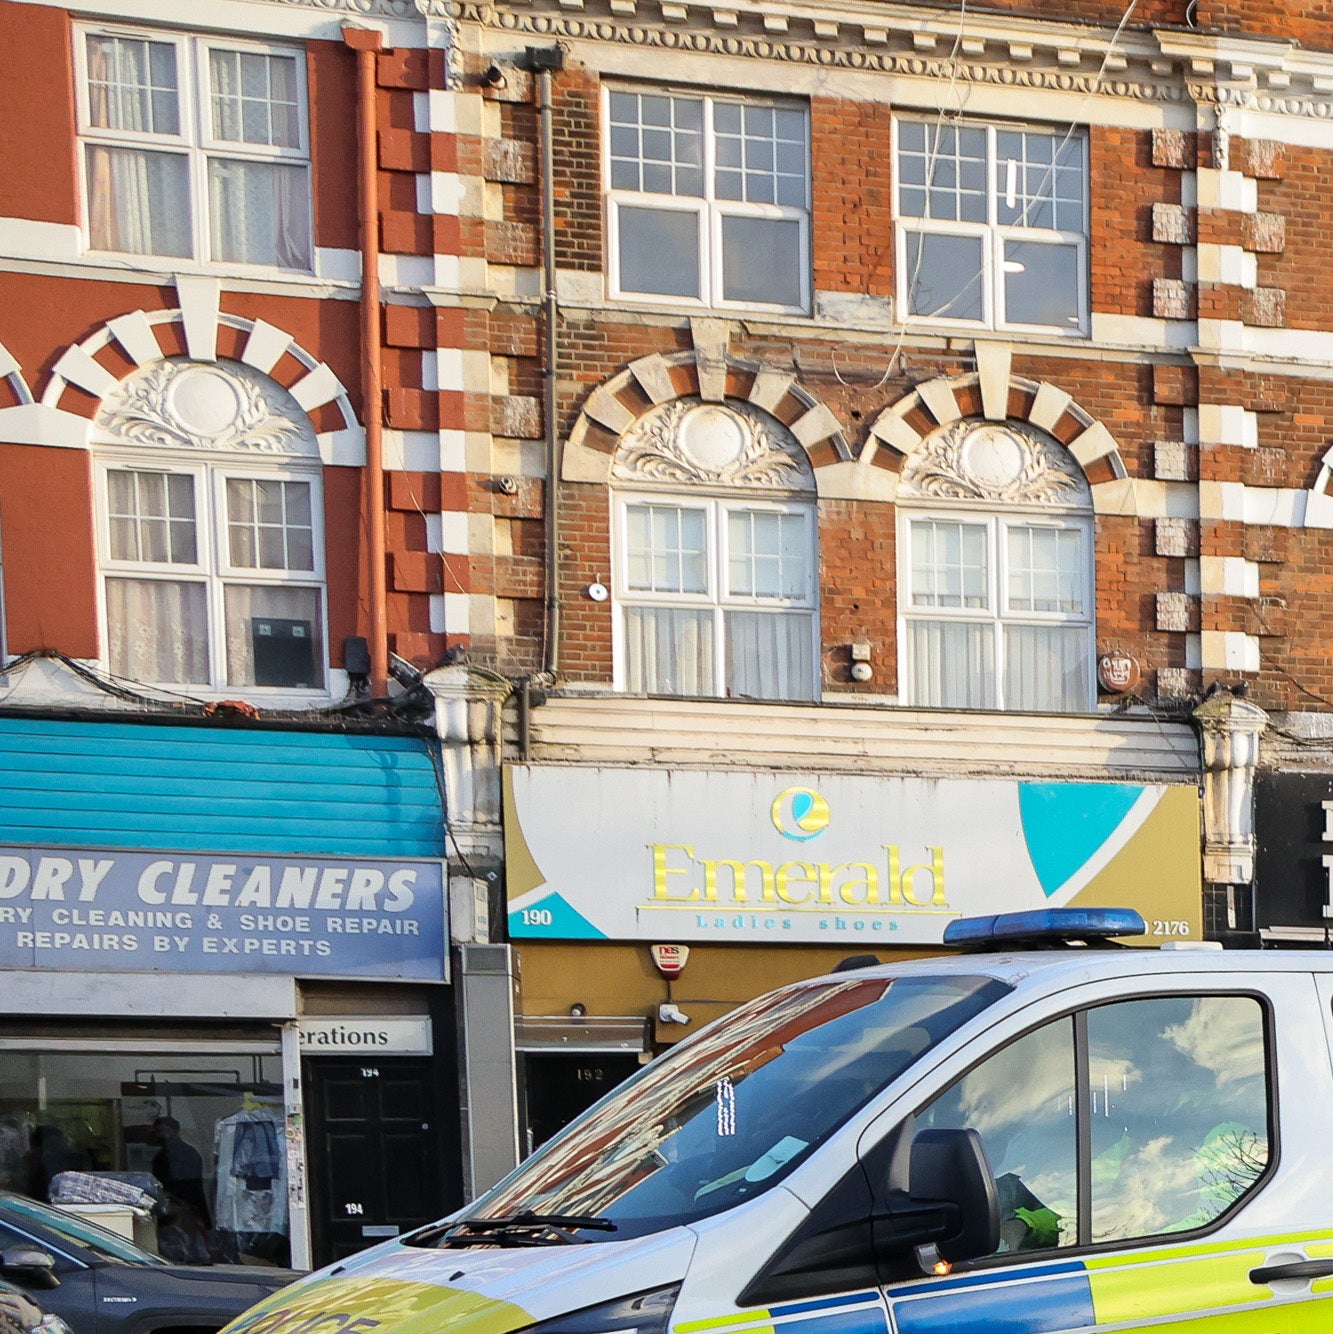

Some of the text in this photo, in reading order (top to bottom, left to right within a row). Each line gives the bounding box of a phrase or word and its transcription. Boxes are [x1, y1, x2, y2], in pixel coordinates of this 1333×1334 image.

[645, 843, 949, 907] Emerald
[0, 856, 417, 912] DRY CLEANERS
[52, 908, 193, 929] CLEANING
[207, 913, 222, 929] &
[239, 914, 310, 932] SHOE
[326, 917, 419, 936] REPAIR
[522, 909, 552, 925] 190
[697, 915, 898, 931] Ladies shoes
[1153, 921, 1190, 936] 2176
[17, 931, 332, 955] REPAIRS BY EXPERTS
[361, 1068, 380, 1077] 194
[345, 1203, 363, 1214] 194
